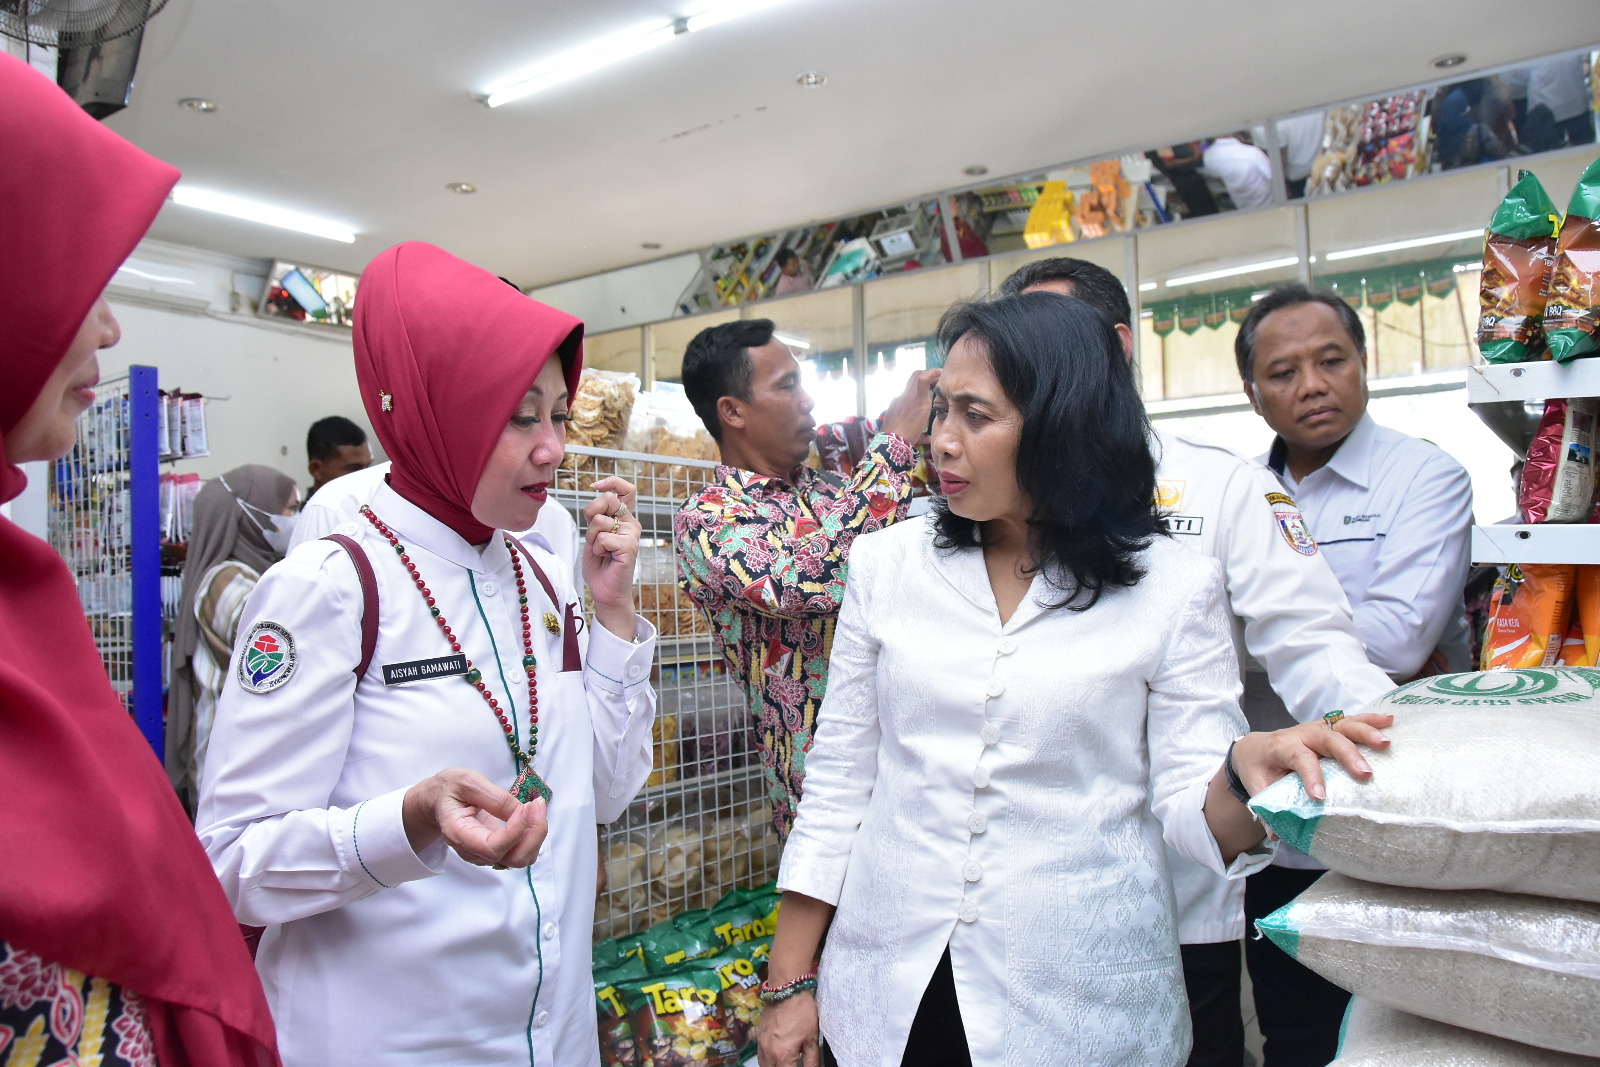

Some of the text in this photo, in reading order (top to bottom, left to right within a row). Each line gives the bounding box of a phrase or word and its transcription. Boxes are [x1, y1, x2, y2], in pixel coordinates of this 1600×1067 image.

[391, 660, 460, 679] AISYAH GAMAWATI
[714, 919, 766, 947] Taro
[641, 982, 717, 1015] Taro
